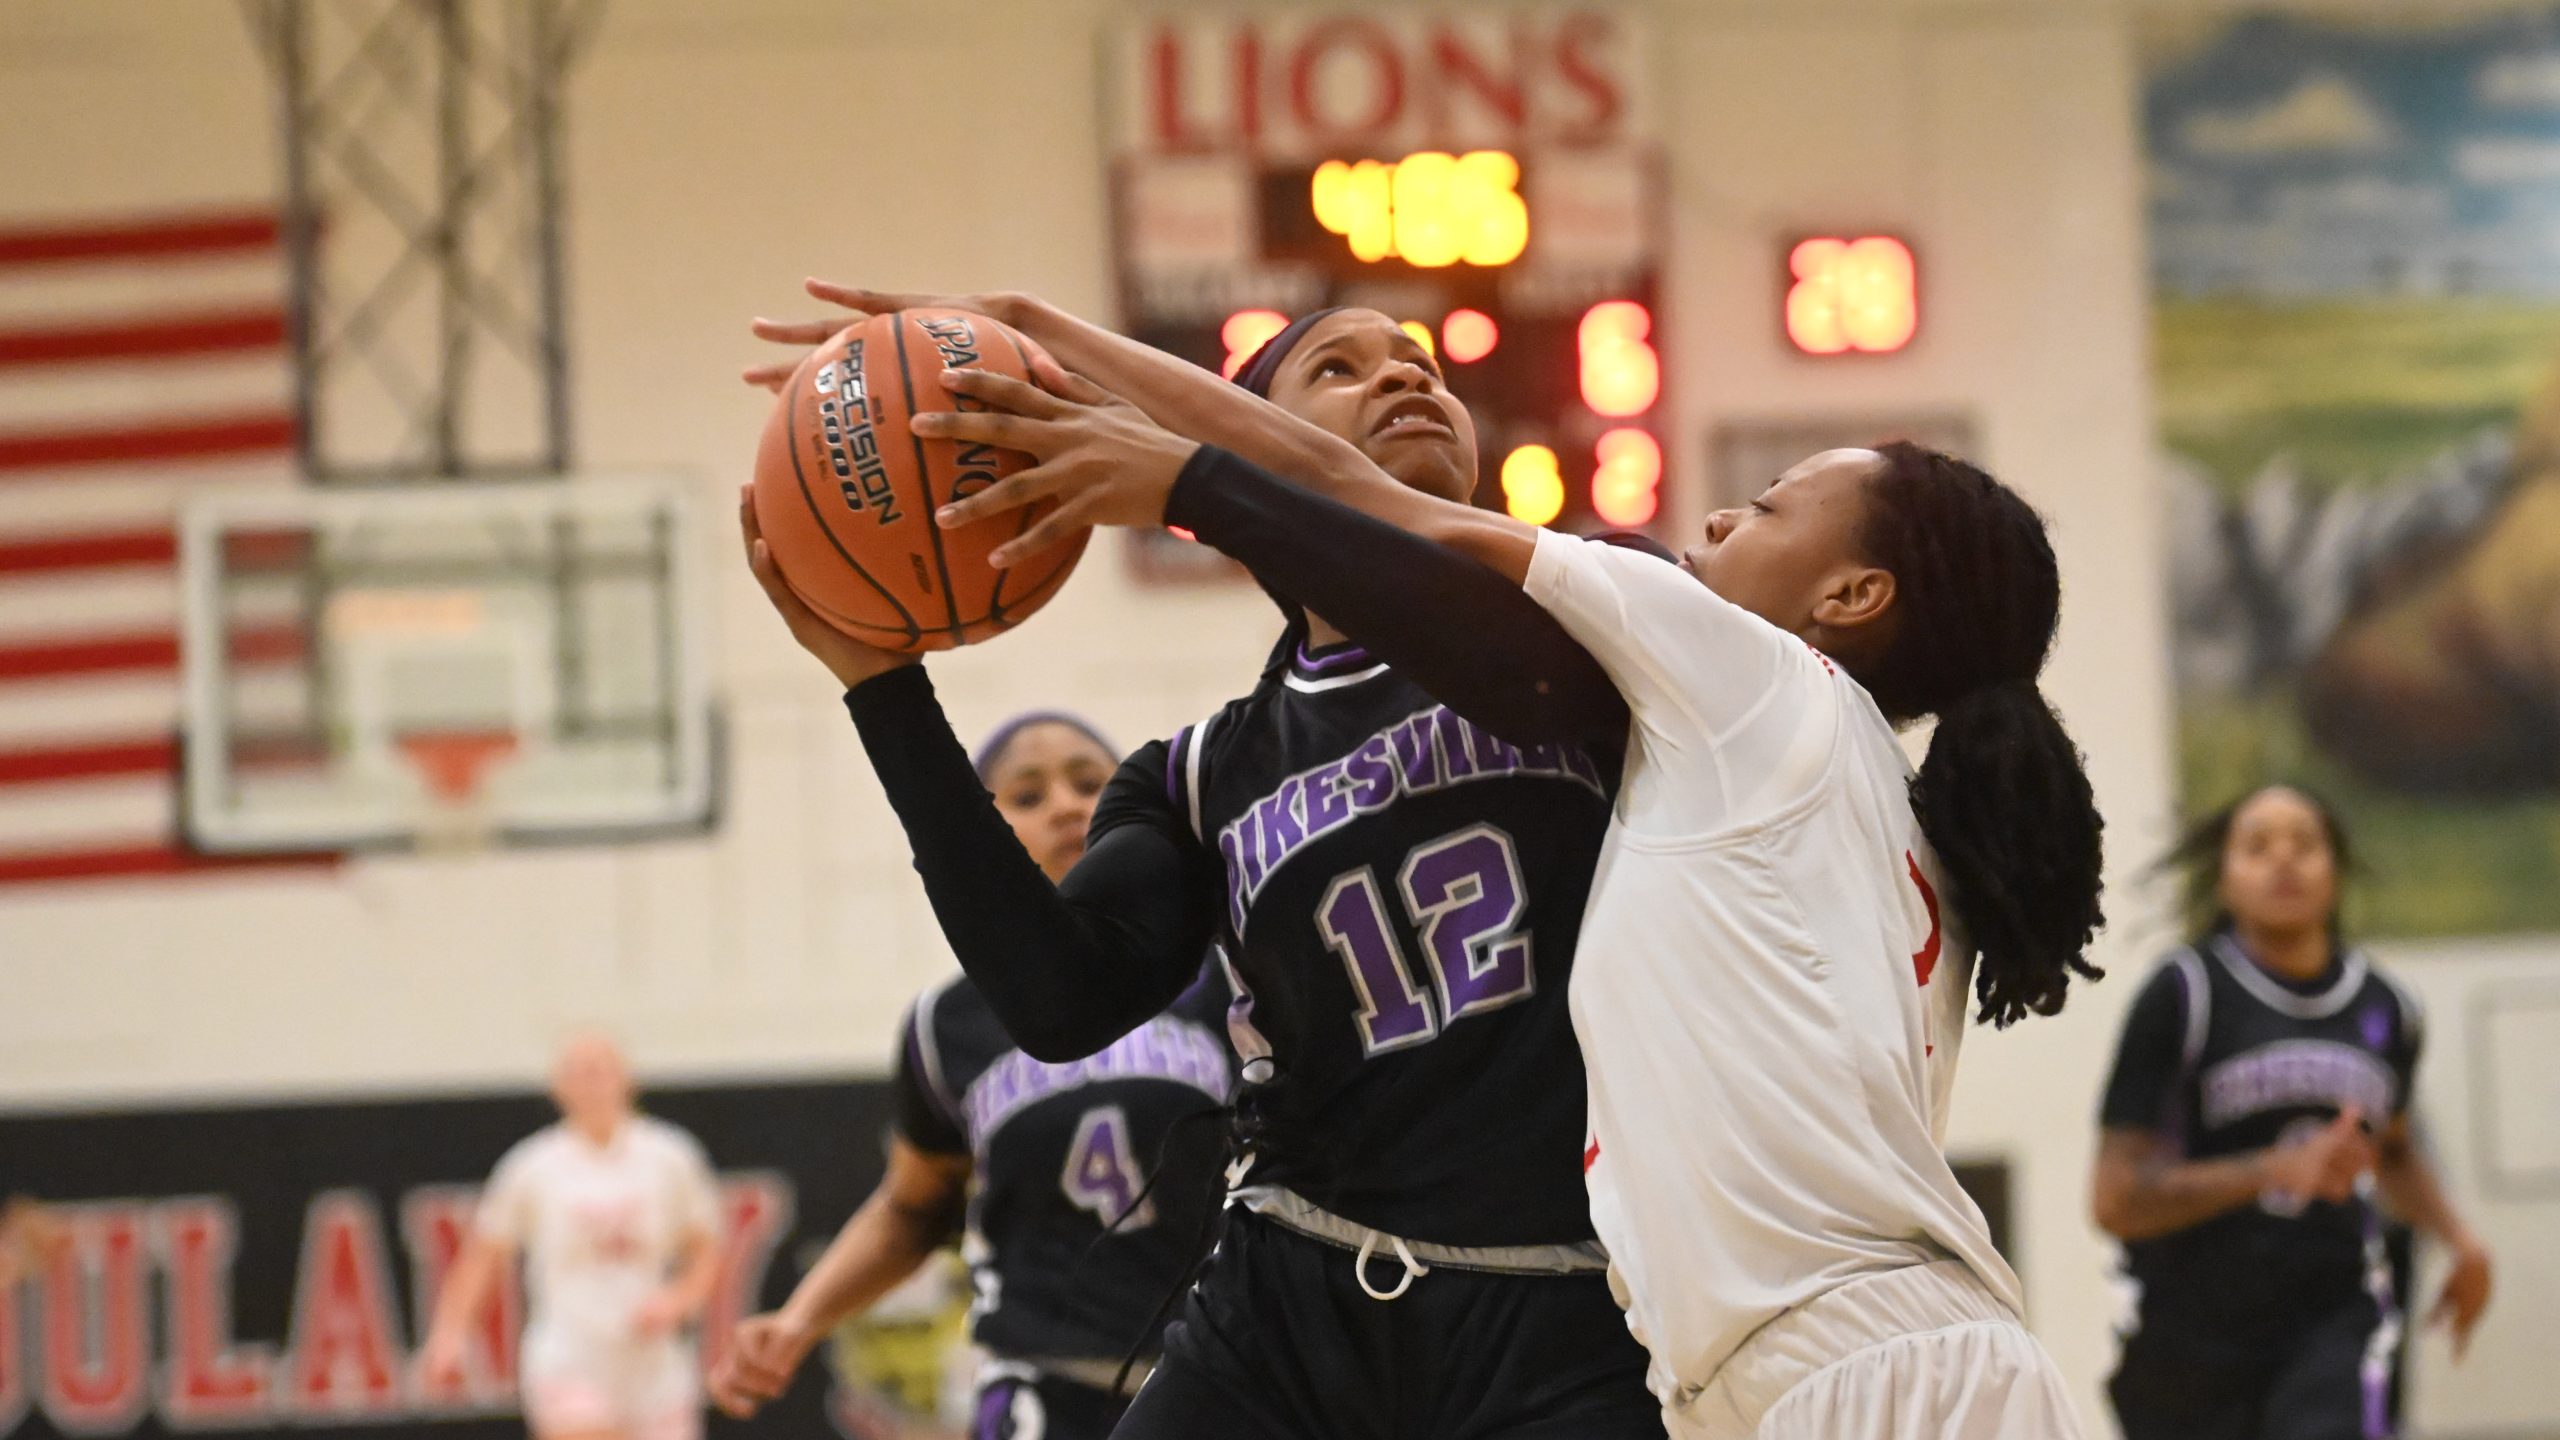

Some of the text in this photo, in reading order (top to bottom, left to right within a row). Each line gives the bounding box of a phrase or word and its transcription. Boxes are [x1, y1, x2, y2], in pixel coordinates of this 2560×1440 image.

[1150, 16, 1623, 153] LIONS
[842, 338, 903, 526] PRECISION
[1314, 821, 1536, 1059] 12
[1061, 1104, 1158, 1235] 4
